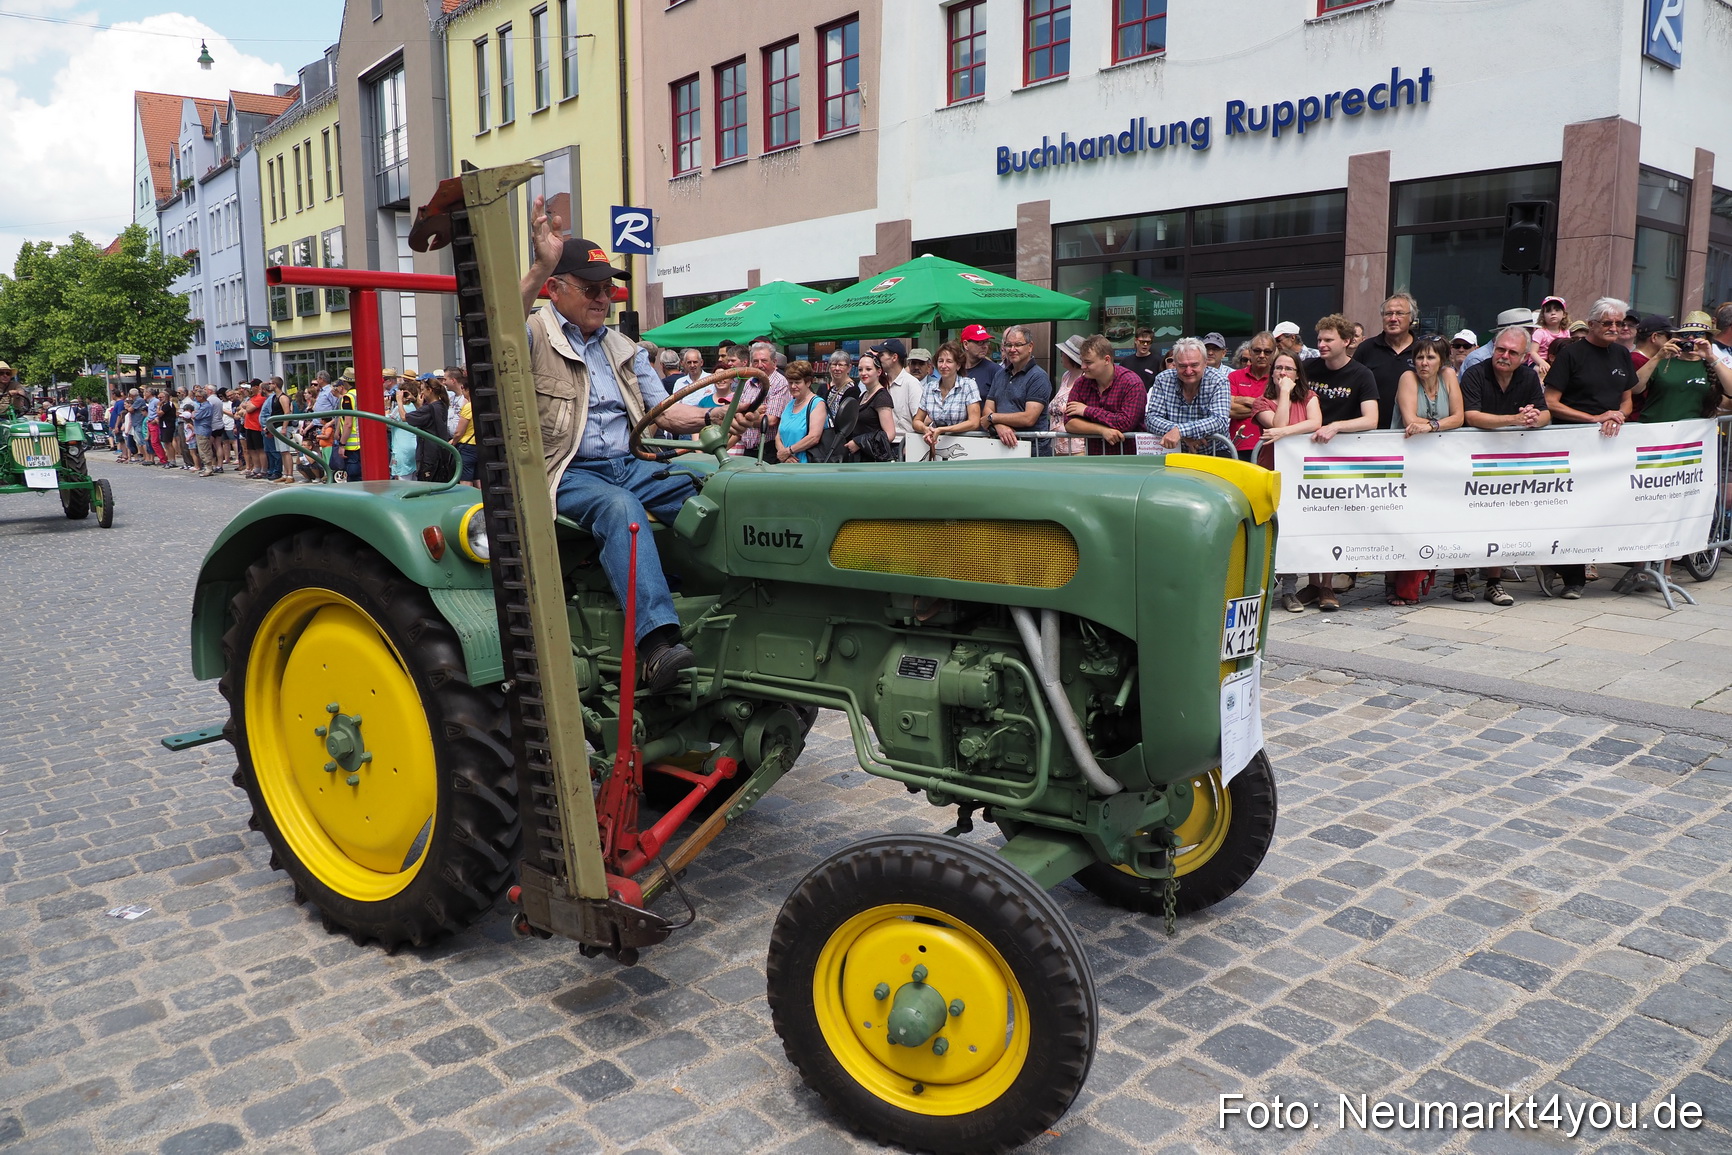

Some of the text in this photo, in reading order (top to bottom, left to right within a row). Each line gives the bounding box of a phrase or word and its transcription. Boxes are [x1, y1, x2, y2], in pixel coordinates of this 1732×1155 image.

[996, 65, 1434, 176] Buchhandlung Rupprecht
[656, 264, 691, 277] Unterer Markt 15
[1153, 298, 1183, 309] MÄNNER
[1107, 306, 1134, 316] OLDTIMER
[1630, 467, 1704, 489] NeuerMarkt
[1297, 482, 1407, 499] NeuerMarkt
[1464, 477, 1574, 496] NeuerMarkt
[1468, 498, 1568, 508] einkaufen leben genießen
[1634, 493, 1667, 502] einkaufen
[1302, 503, 1404, 512] einkaufen leben genießen
[743, 524, 803, 549] Bautz
[1345, 545, 1389, 553] Dammstraße
[1518, 541, 1532, 549] 500
[1560, 546, 1604, 555] NM-Neumarkt
[1237, 600, 1259, 628] NM
